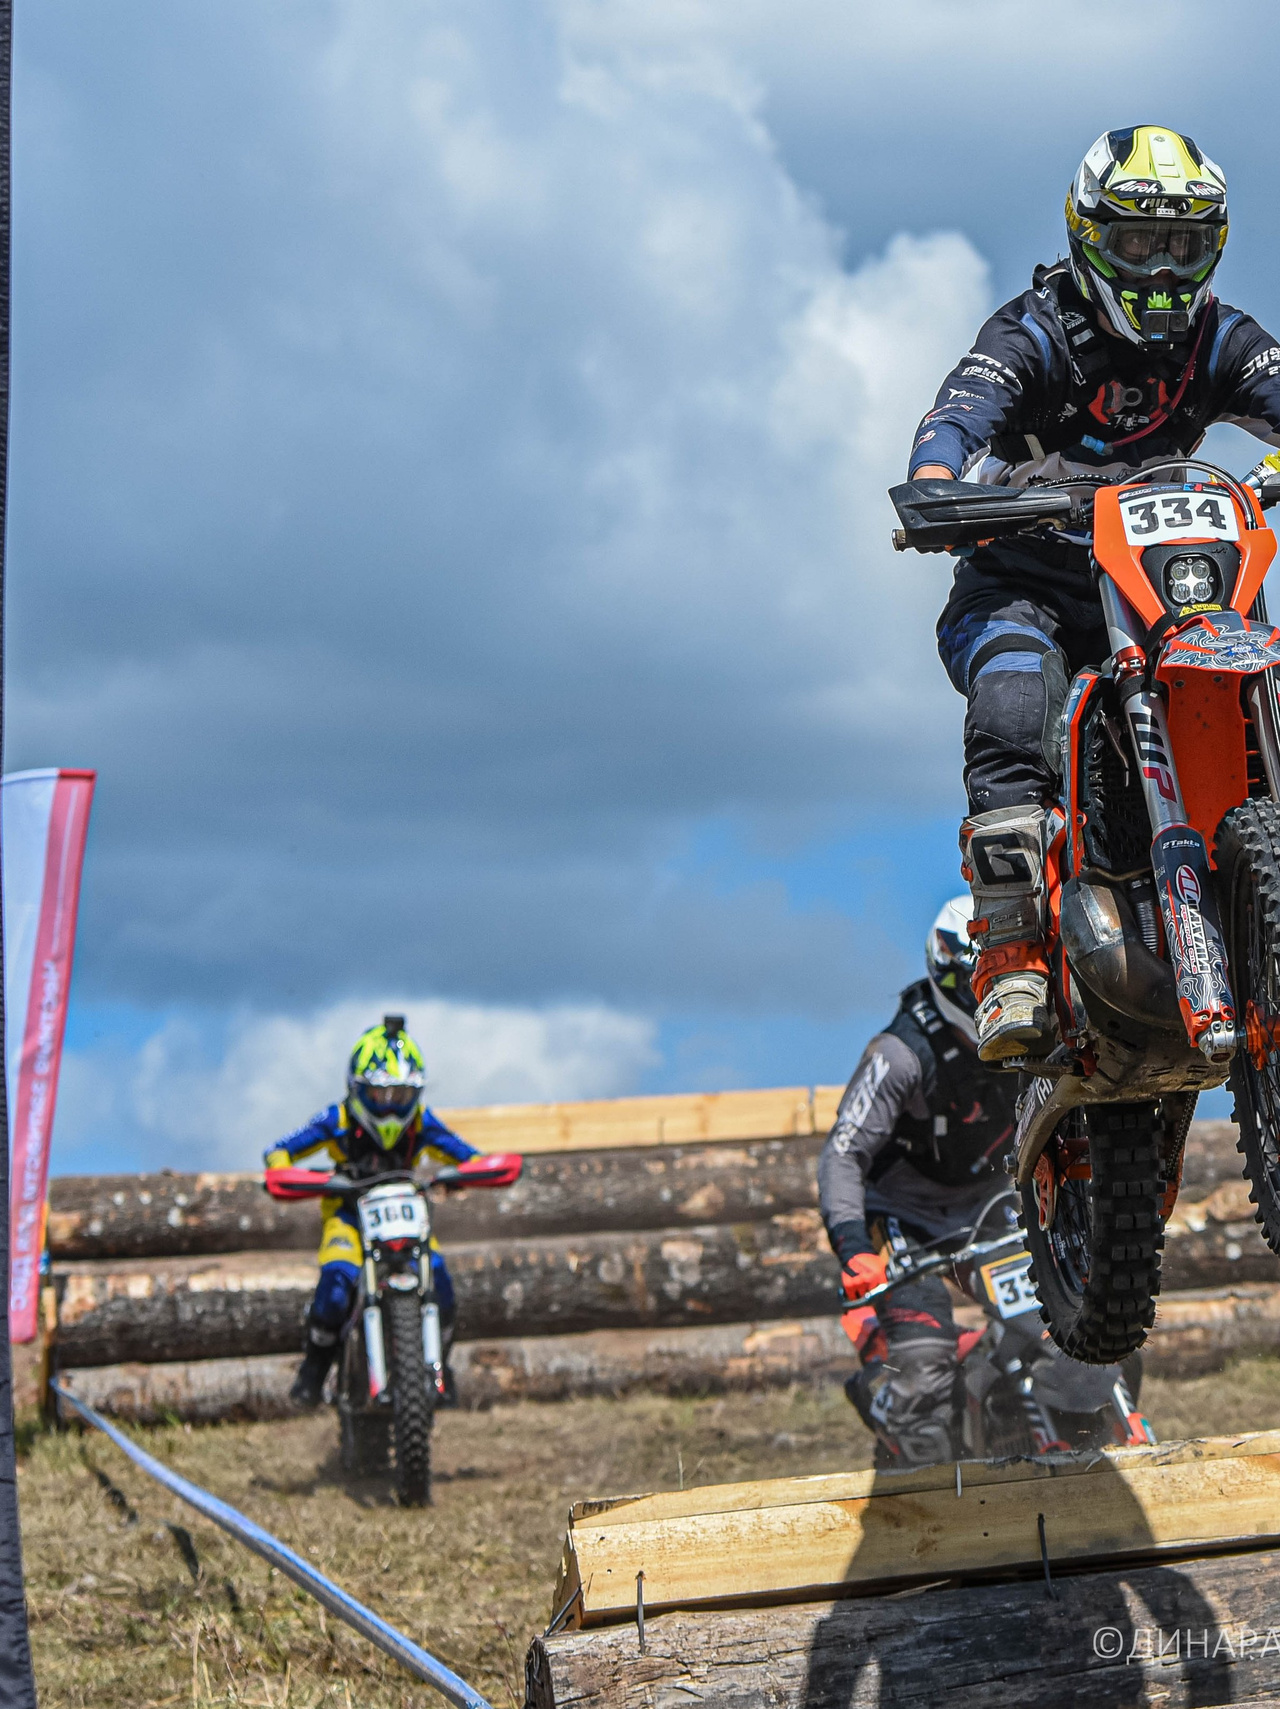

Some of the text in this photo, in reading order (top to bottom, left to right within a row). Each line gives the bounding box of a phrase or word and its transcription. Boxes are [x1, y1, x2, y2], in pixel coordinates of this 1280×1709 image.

[1113, 181, 1159, 195] Airoh
[1128, 498, 1227, 534] 334
[1162, 839, 1200, 849] 2Takta
[1180, 904, 1198, 975] RACING OILS
[1185, 892, 1212, 974] MAXIMA
